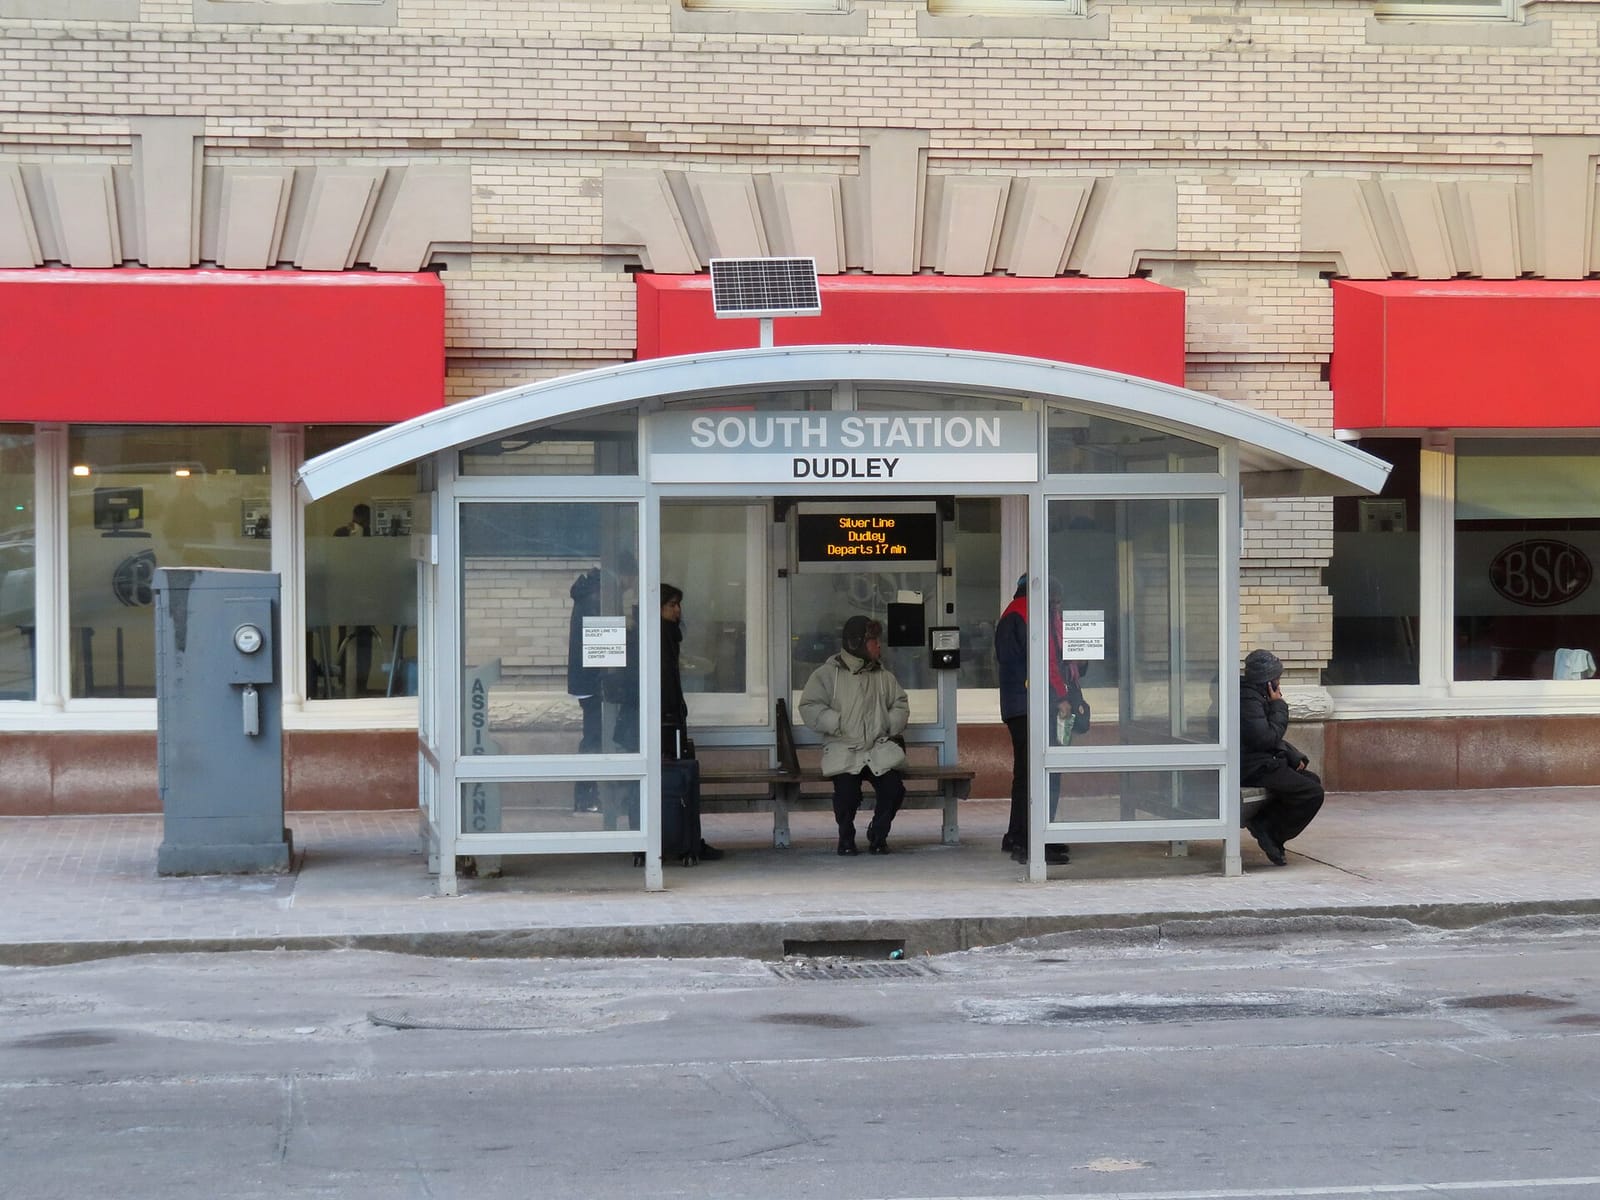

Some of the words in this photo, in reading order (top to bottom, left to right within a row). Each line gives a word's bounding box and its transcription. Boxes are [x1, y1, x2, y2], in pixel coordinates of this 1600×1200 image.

[690, 416, 827, 448] SOUTH
[840, 416, 1001, 448] STATION
[793, 458, 899, 478] DUDLEY
[839, 517, 870, 528] Silver
[872, 517, 895, 528] Line
[848, 531, 886, 543] Dudley
[827, 544, 873, 556] Departs
[875, 544, 888, 554] 17
[890, 544, 907, 554] min
[1503, 546, 1577, 600] BSC
[471, 678, 486, 831] ASSIANC
